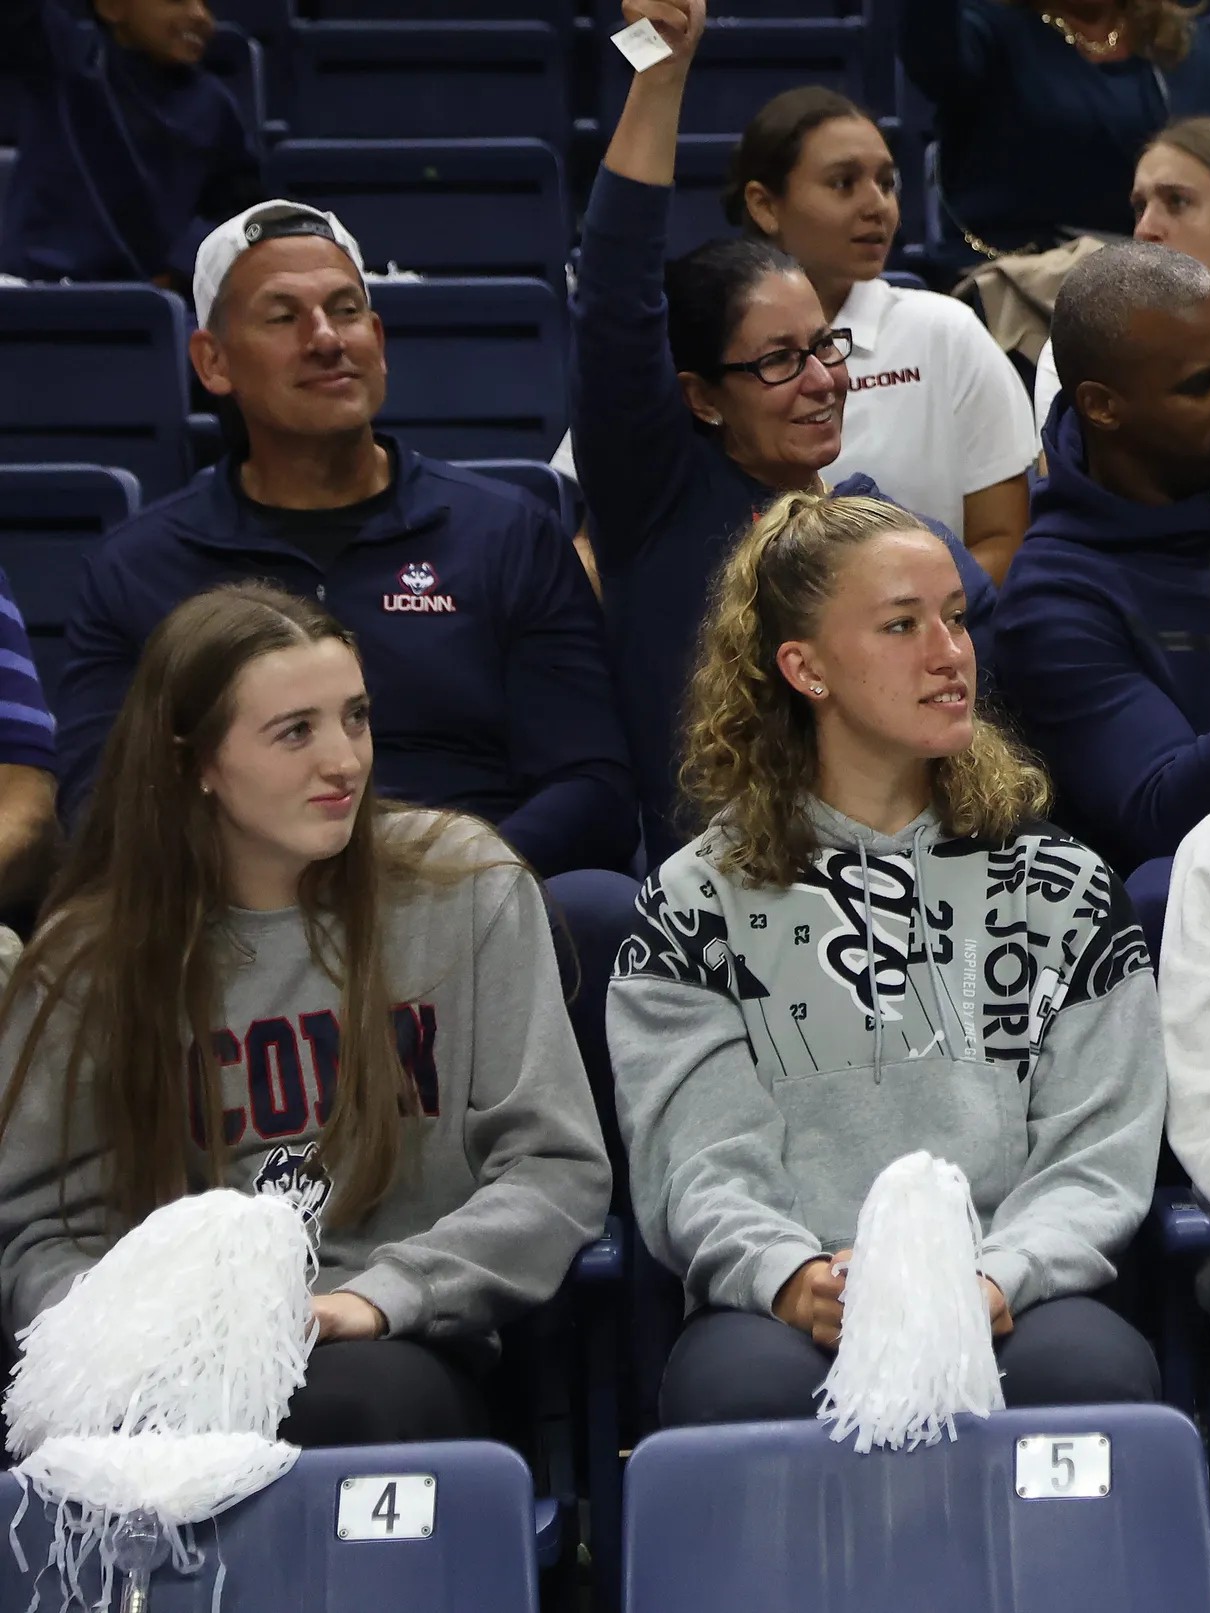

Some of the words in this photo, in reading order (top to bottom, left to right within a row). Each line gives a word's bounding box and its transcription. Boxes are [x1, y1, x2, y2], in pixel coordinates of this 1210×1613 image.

[848, 367, 921, 392] UCONN
[383, 594, 453, 612] UCONN
[750, 914, 767, 929] 23
[794, 924, 809, 945] 23
[963, 938, 977, 998] INSPIRED
[790, 1003, 807, 1020] 23
[1051, 1442, 1076, 1492] 5
[371, 1481, 401, 1534] 4
